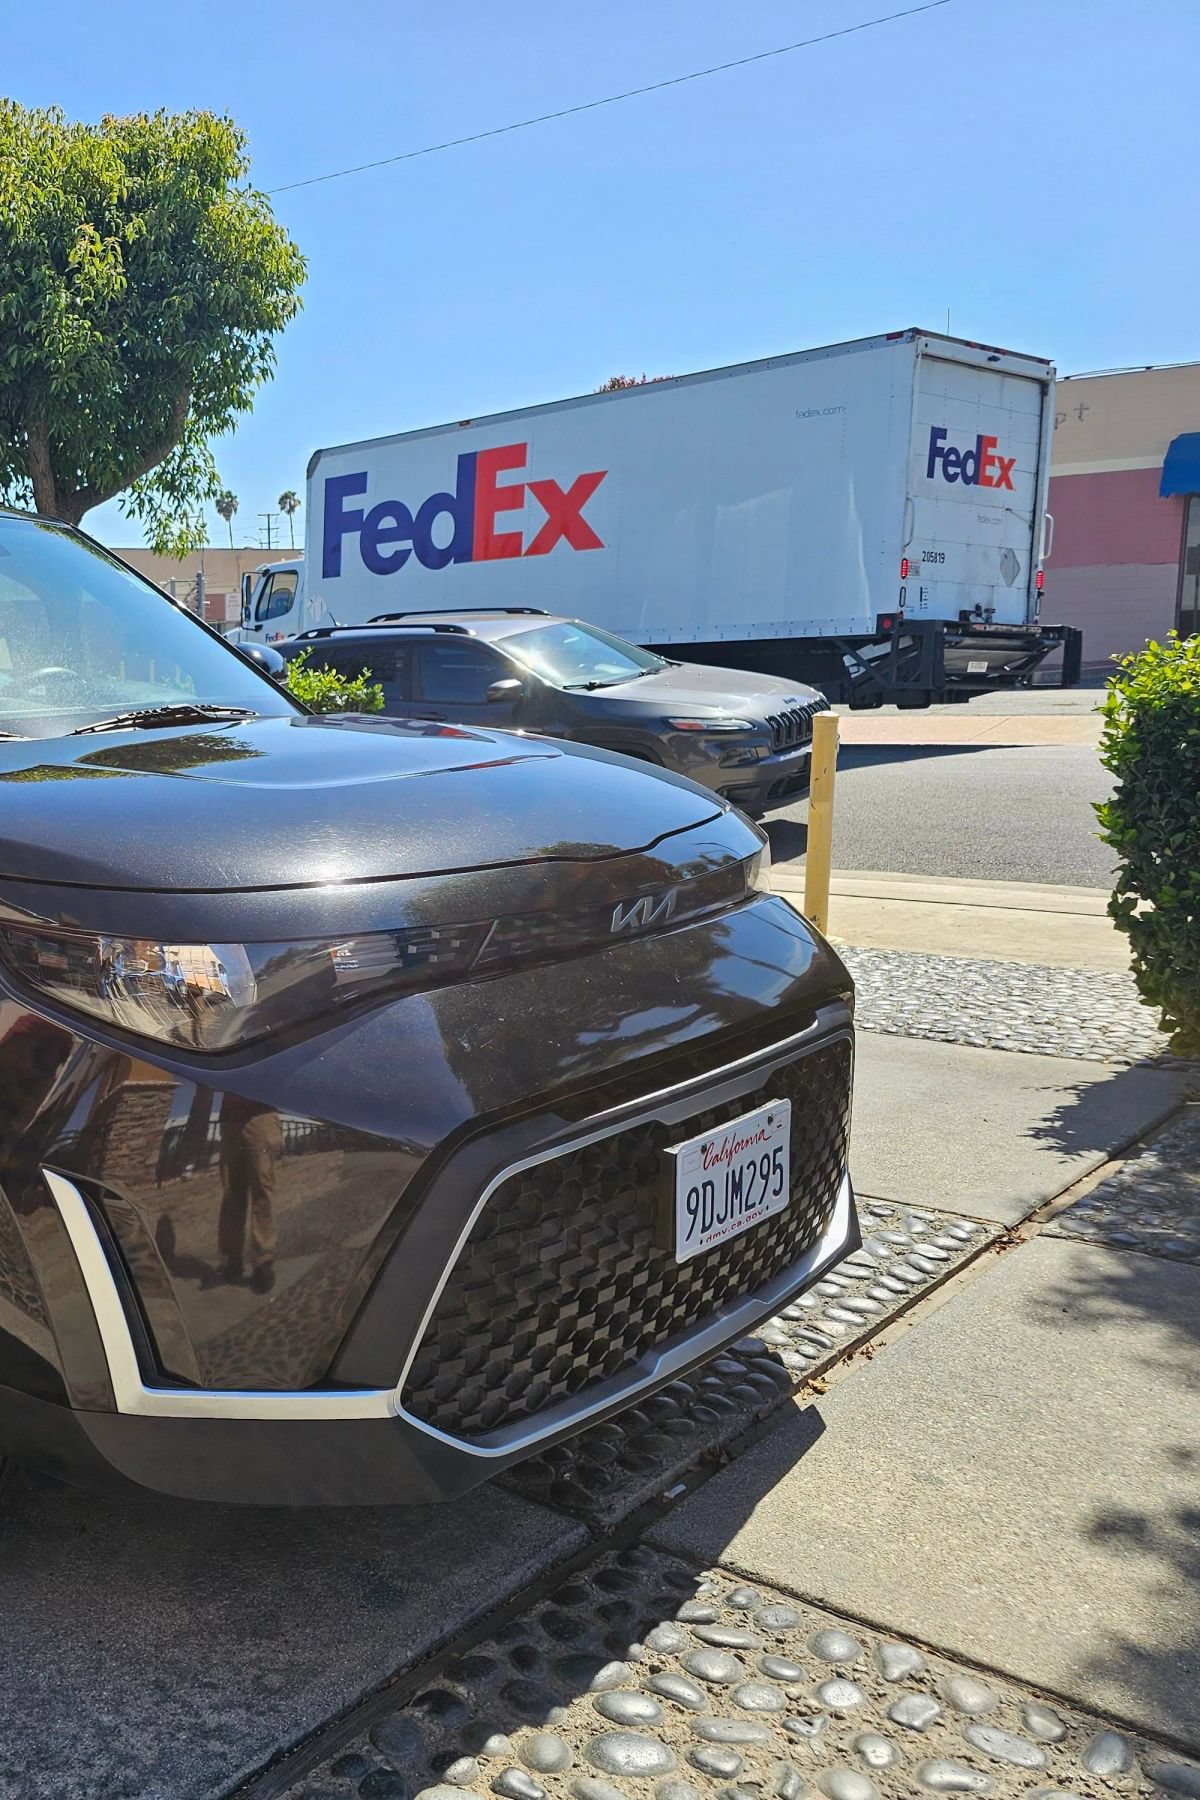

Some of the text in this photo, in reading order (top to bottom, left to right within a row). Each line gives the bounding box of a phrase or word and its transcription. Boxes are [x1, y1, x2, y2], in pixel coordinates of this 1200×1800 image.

[926, 426, 1017, 491] FedEx
[322, 442, 609, 579] FedEx
[703, 1123, 772, 1171] California
[685, 1145, 784, 1242] 9DJM295
